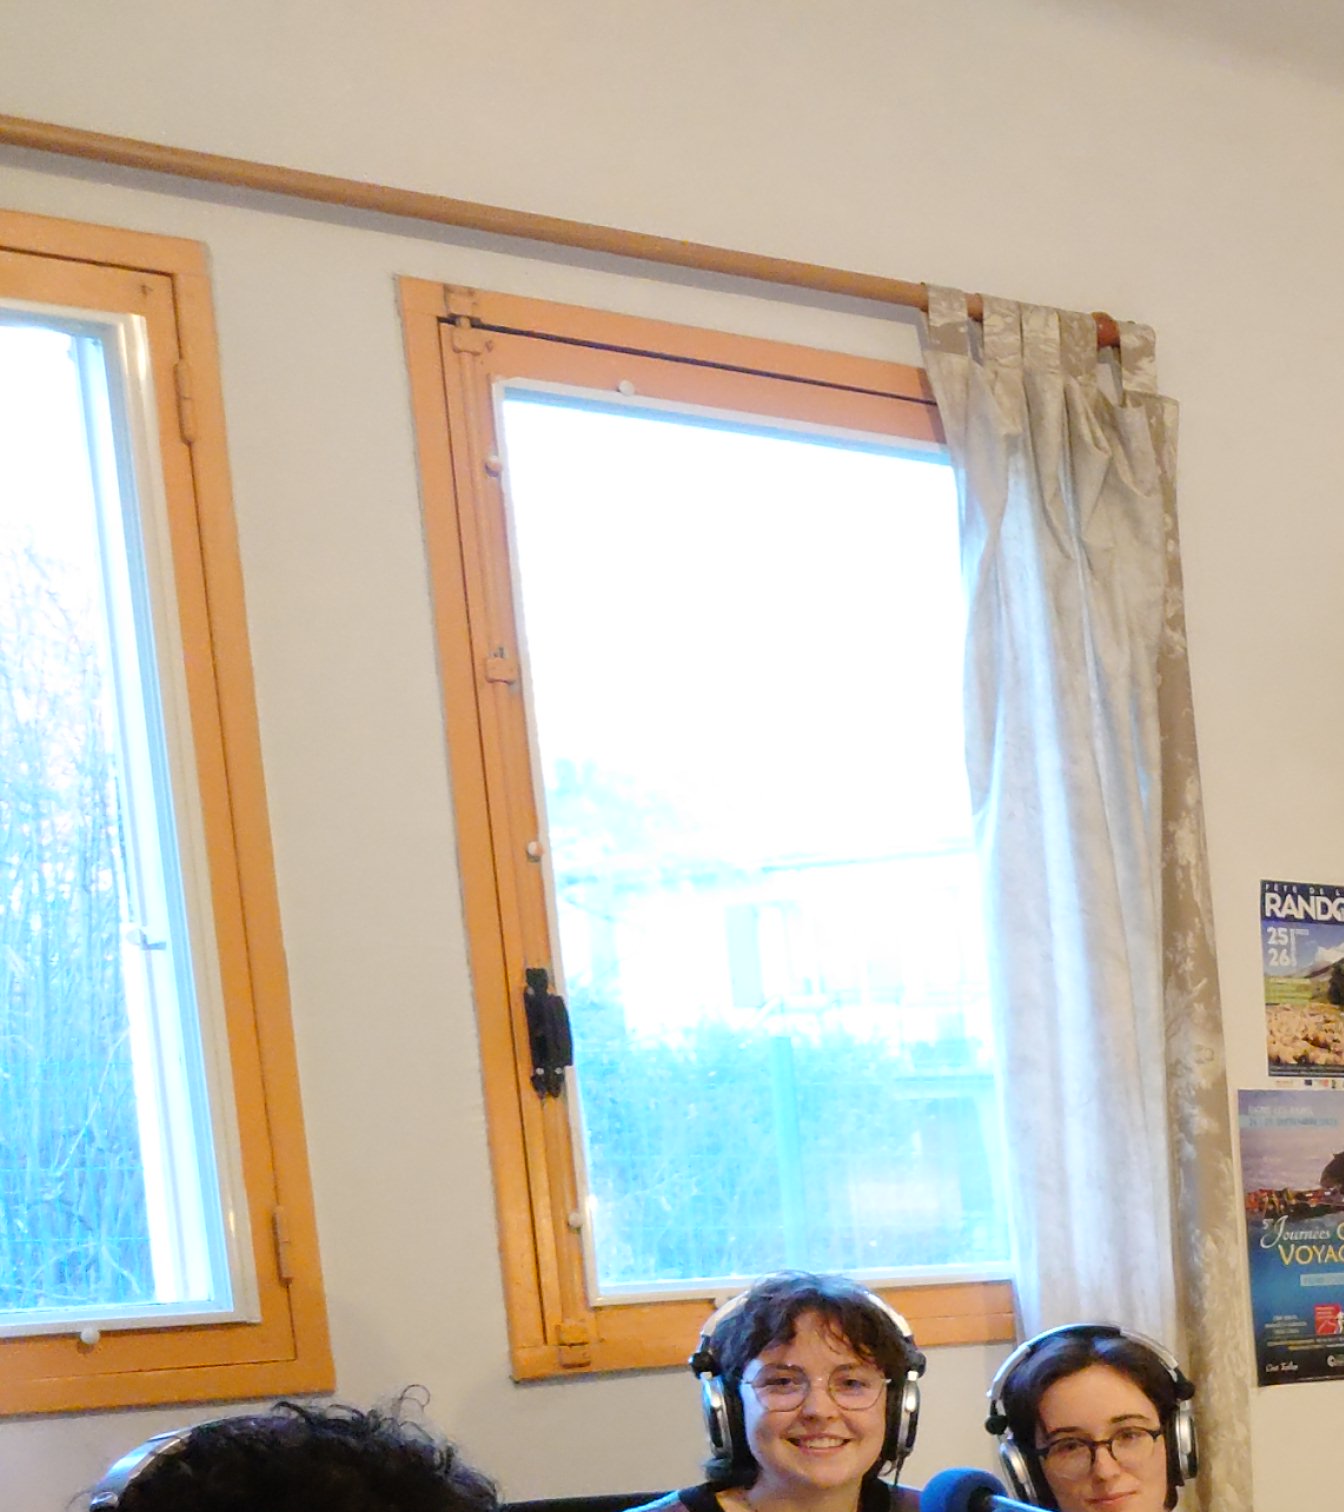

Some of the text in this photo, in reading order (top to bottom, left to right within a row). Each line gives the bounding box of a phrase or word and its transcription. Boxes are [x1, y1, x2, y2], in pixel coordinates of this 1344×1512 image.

[1309, 886, 1325, 895] DE
[1267, 927, 1289, 945] 25
[1268, 948, 1290, 966] 26
[1260, 1215, 1331, 1249] Journées
